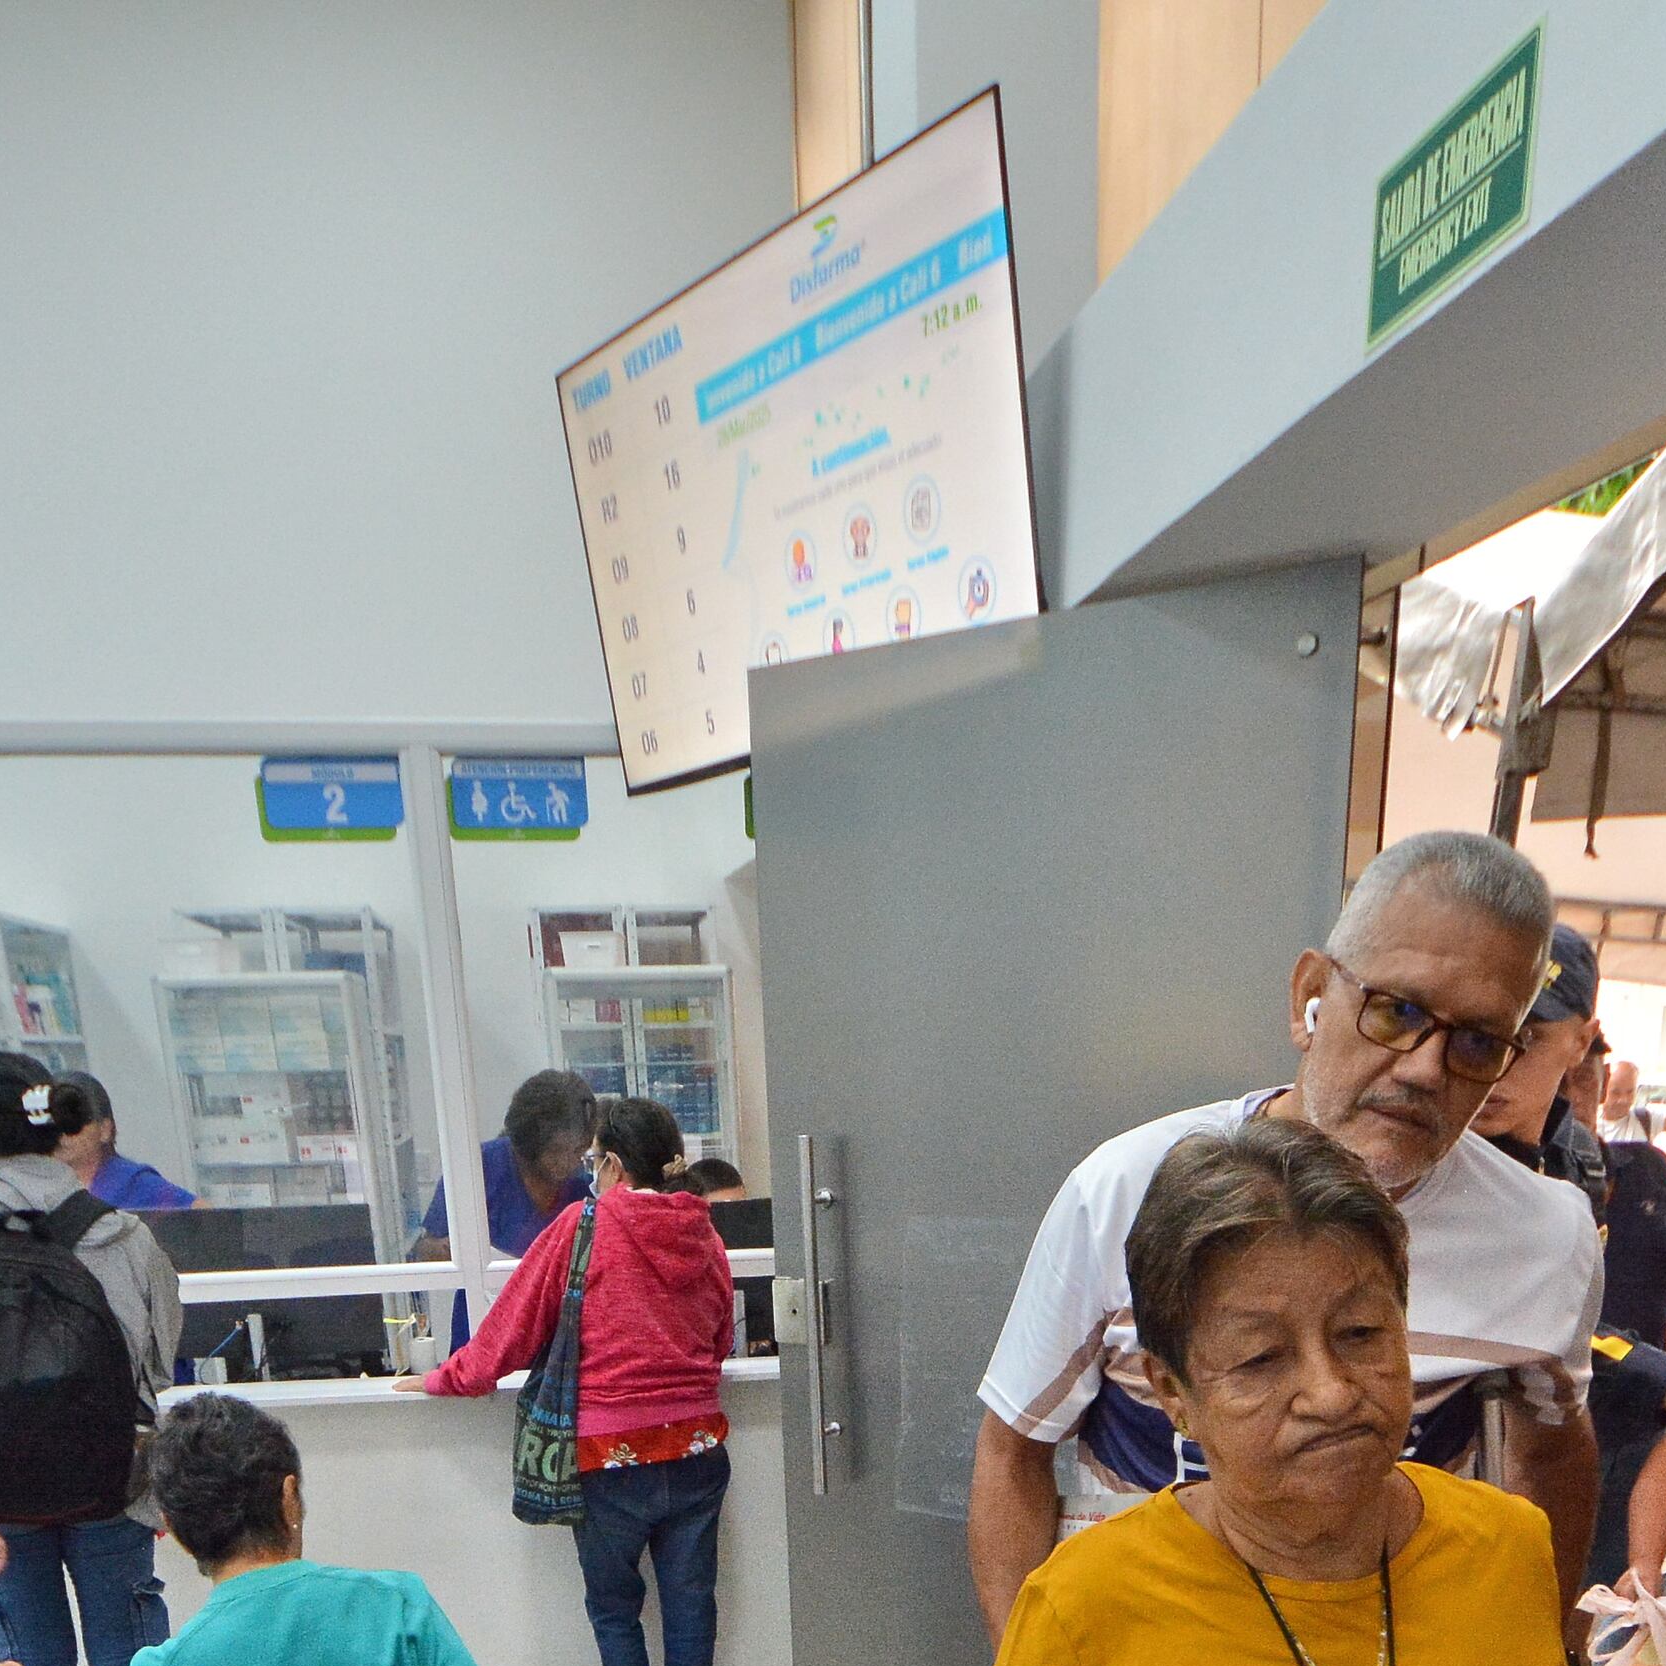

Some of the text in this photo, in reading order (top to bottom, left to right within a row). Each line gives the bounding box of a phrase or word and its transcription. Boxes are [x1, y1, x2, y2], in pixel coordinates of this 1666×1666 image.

[1380, 65, 1527, 260] SALIDA DE EMERGENCIA
[1398, 174, 1493, 295] EMERGENCY EXIT
[789, 243, 861, 303] Disfarma
[921, 303, 948, 337] 7:12
[572, 326, 683, 414] TURNO VENTANA
[654, 394, 671, 427] 10
[677, 524, 686, 554] 9
[686, 588, 696, 615] 6
[697, 650, 706, 675] 4
[705, 709, 715, 735] 5
[323, 783, 349, 823] 2
